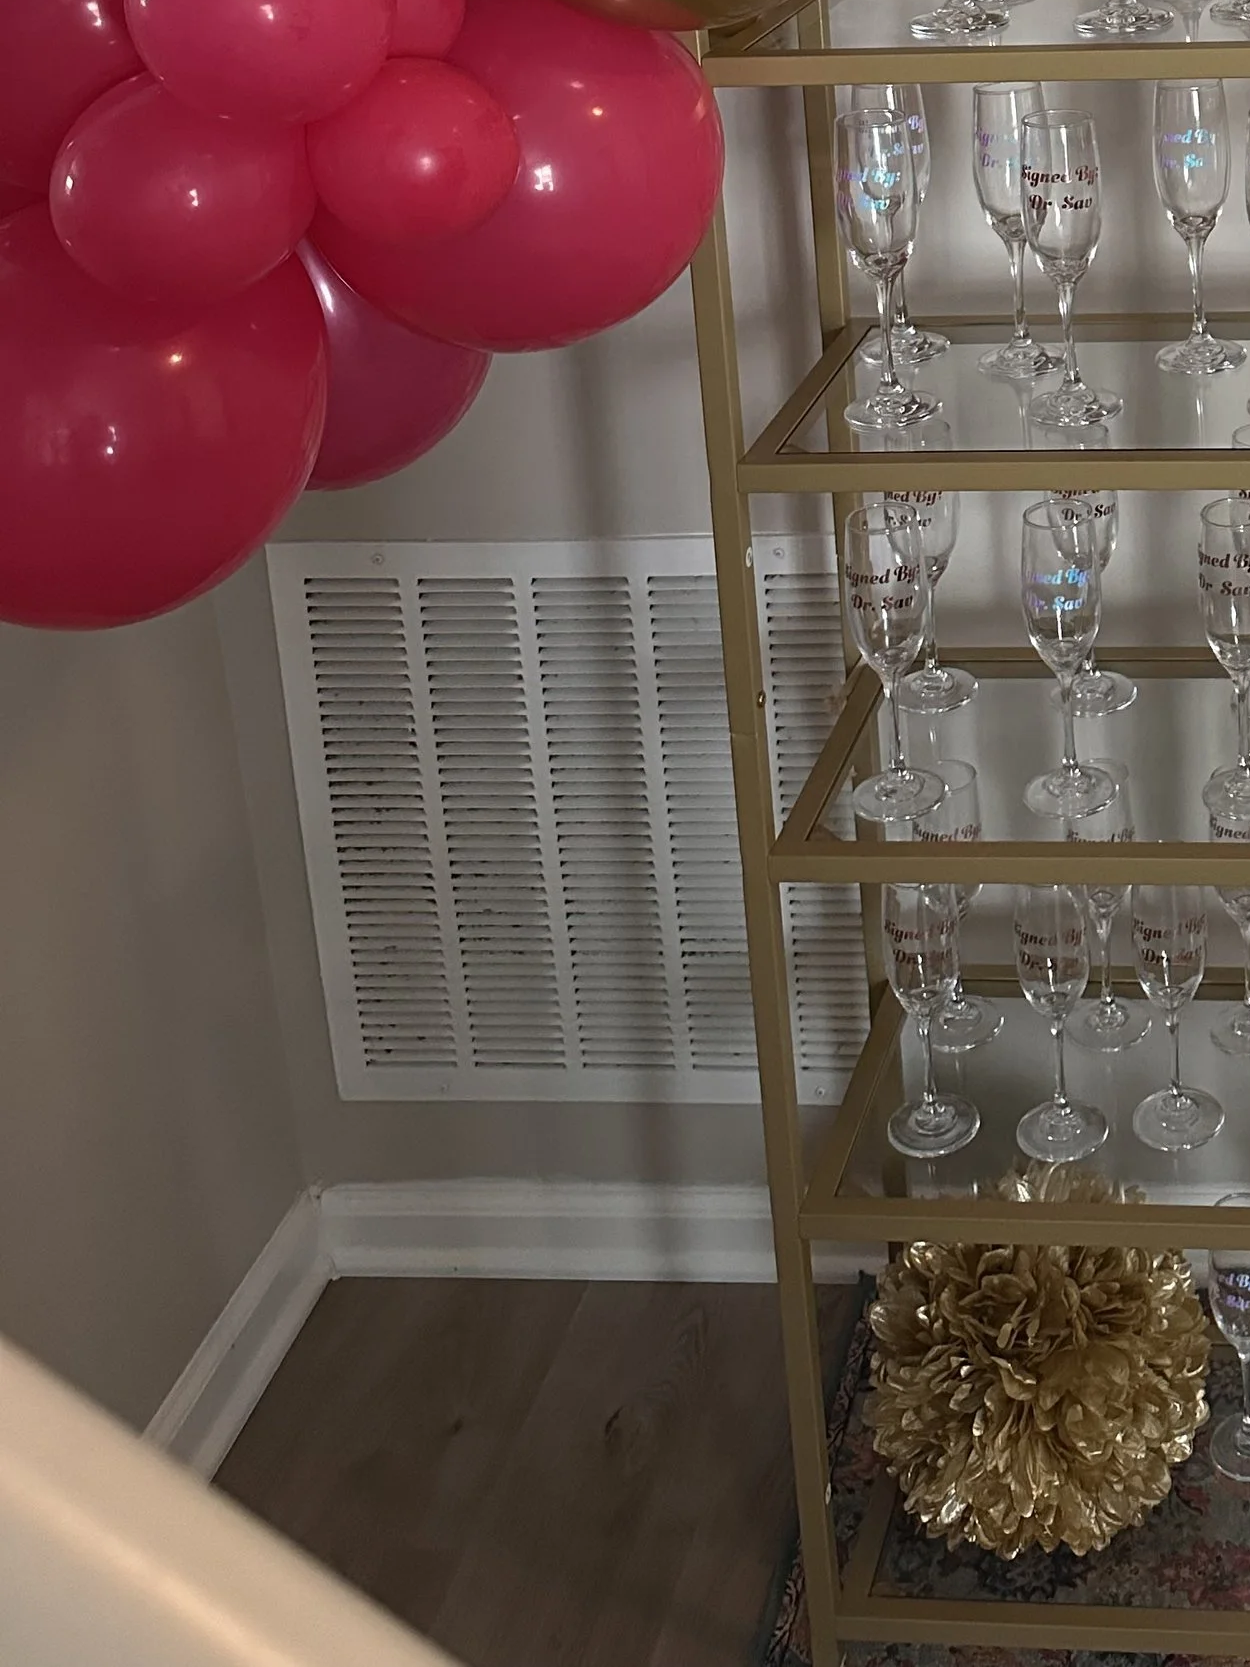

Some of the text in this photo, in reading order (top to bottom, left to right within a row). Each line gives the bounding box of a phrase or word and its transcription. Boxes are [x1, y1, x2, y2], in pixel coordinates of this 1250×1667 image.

[1061, 196, 1092, 211] Sav
[884, 491, 910, 503] ned
[845, 564, 891, 588] igned
[851, 594, 914, 611] Dr. Sav
